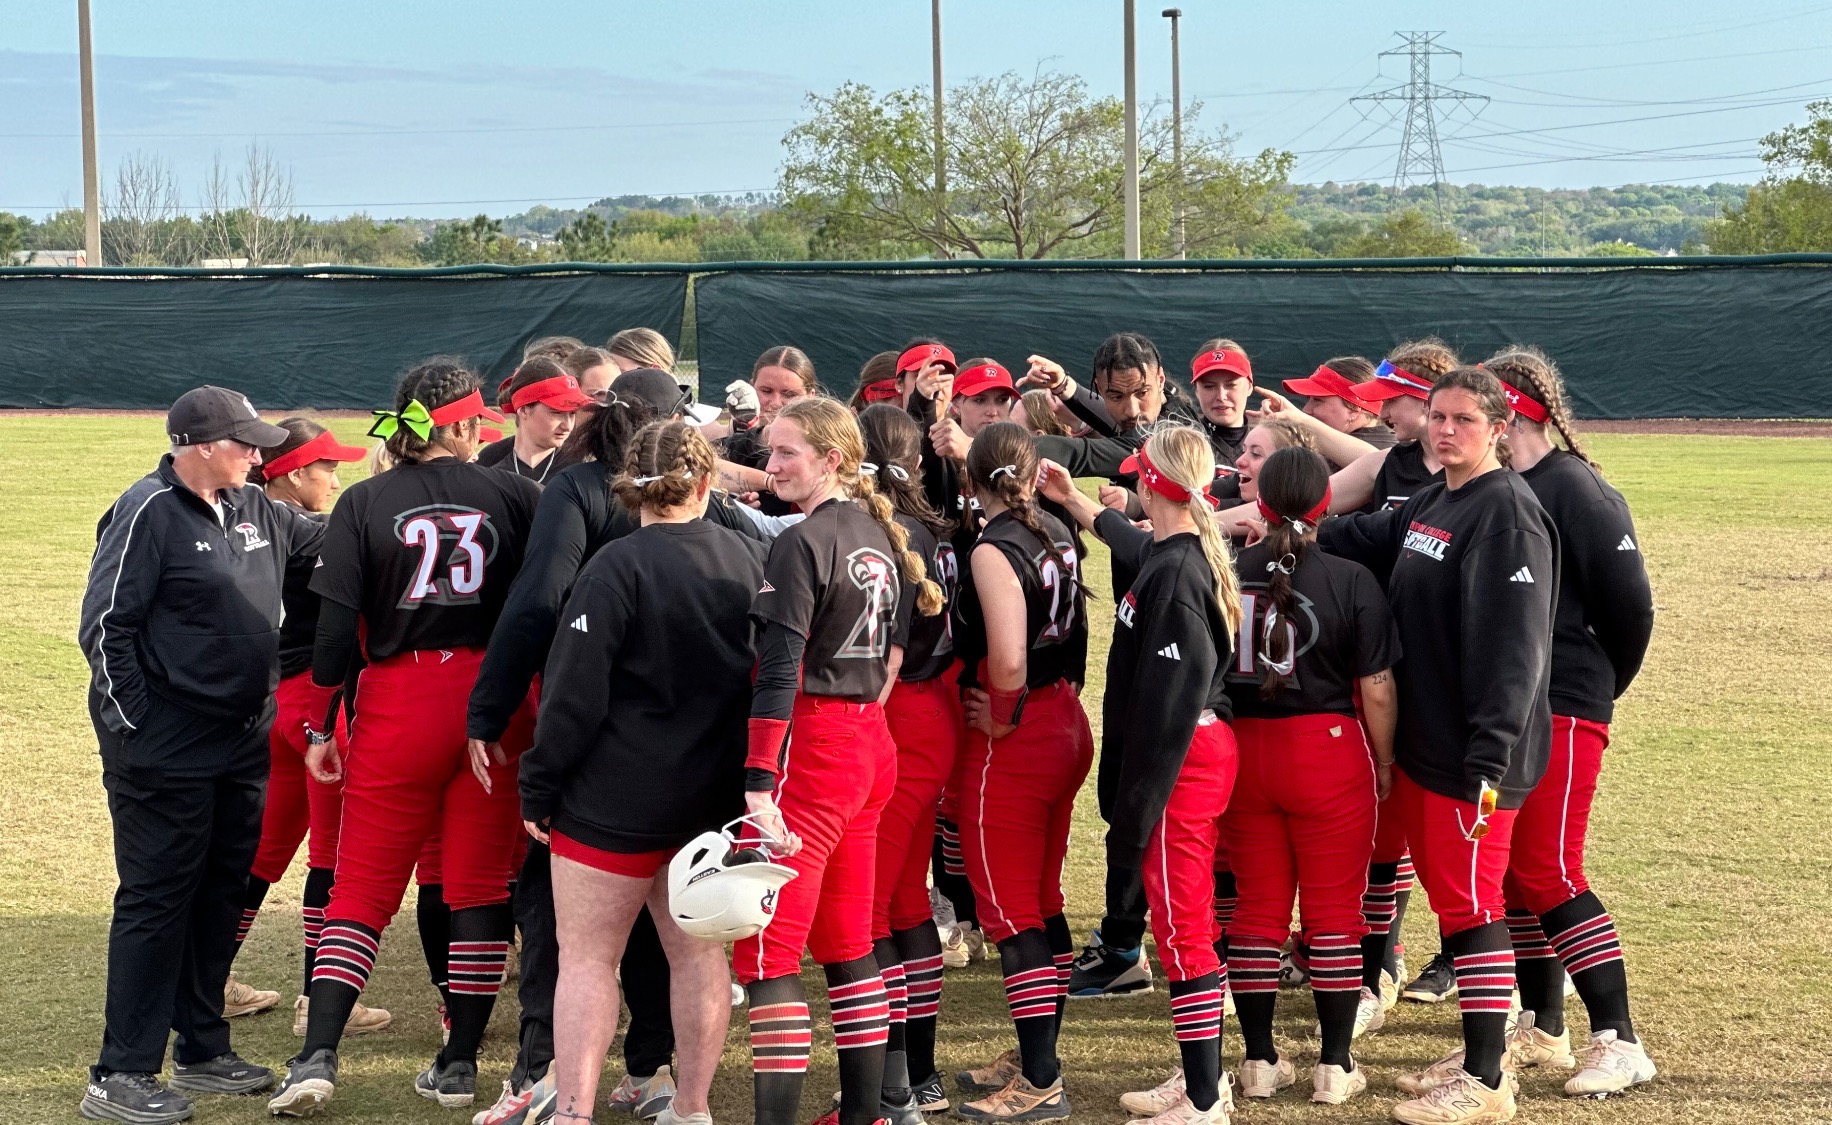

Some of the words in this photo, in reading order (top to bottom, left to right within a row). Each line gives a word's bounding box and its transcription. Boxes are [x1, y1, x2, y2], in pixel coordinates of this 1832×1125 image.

[403, 512, 485, 601] 23
[1041, 547, 1078, 641] 27
[87, 1082, 108, 1100] HOKA
